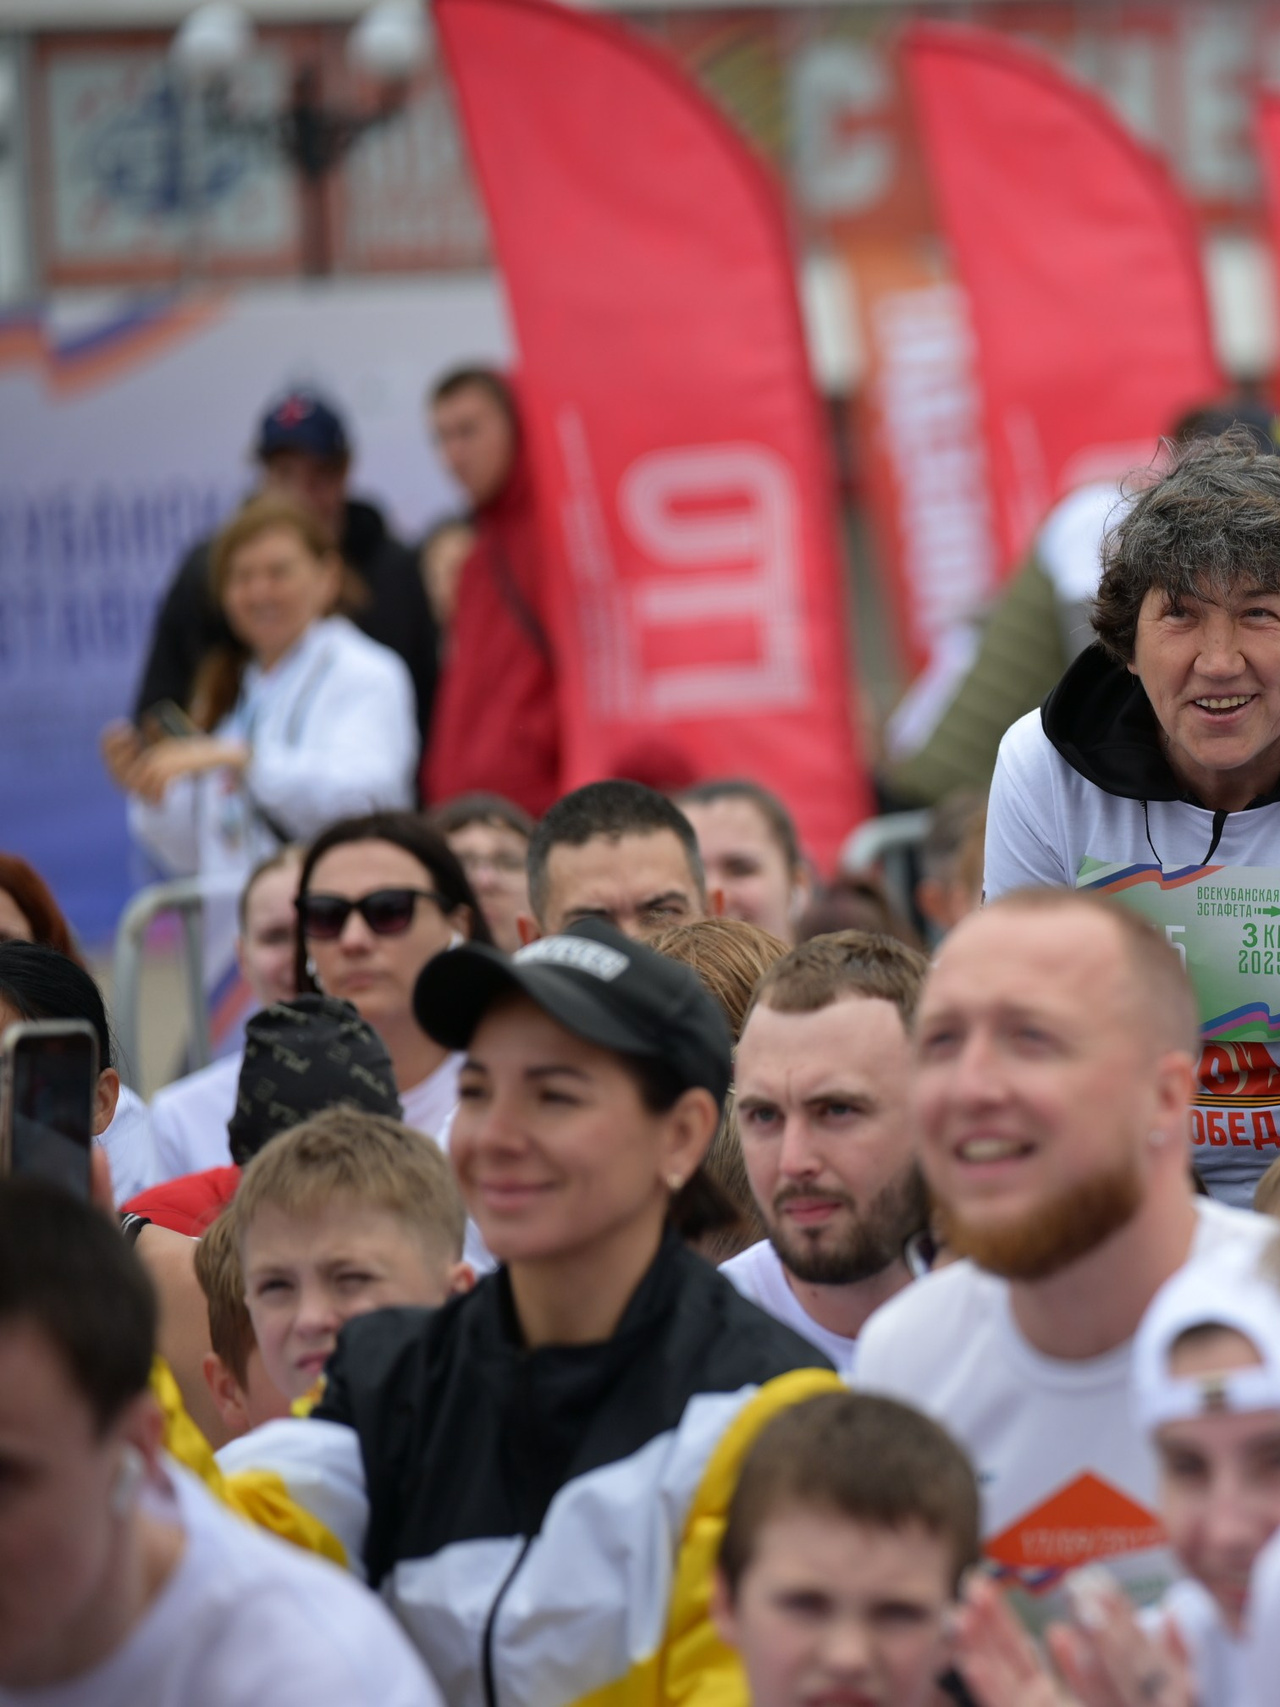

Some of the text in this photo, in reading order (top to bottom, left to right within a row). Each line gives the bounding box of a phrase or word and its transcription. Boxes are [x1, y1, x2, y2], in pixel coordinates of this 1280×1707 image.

[1197, 886, 1280, 903] ВСЕКУБАНСКАЯ
[1197, 902, 1253, 918] ЭСТАФЕТА
[1242, 923, 1258, 948] 3
